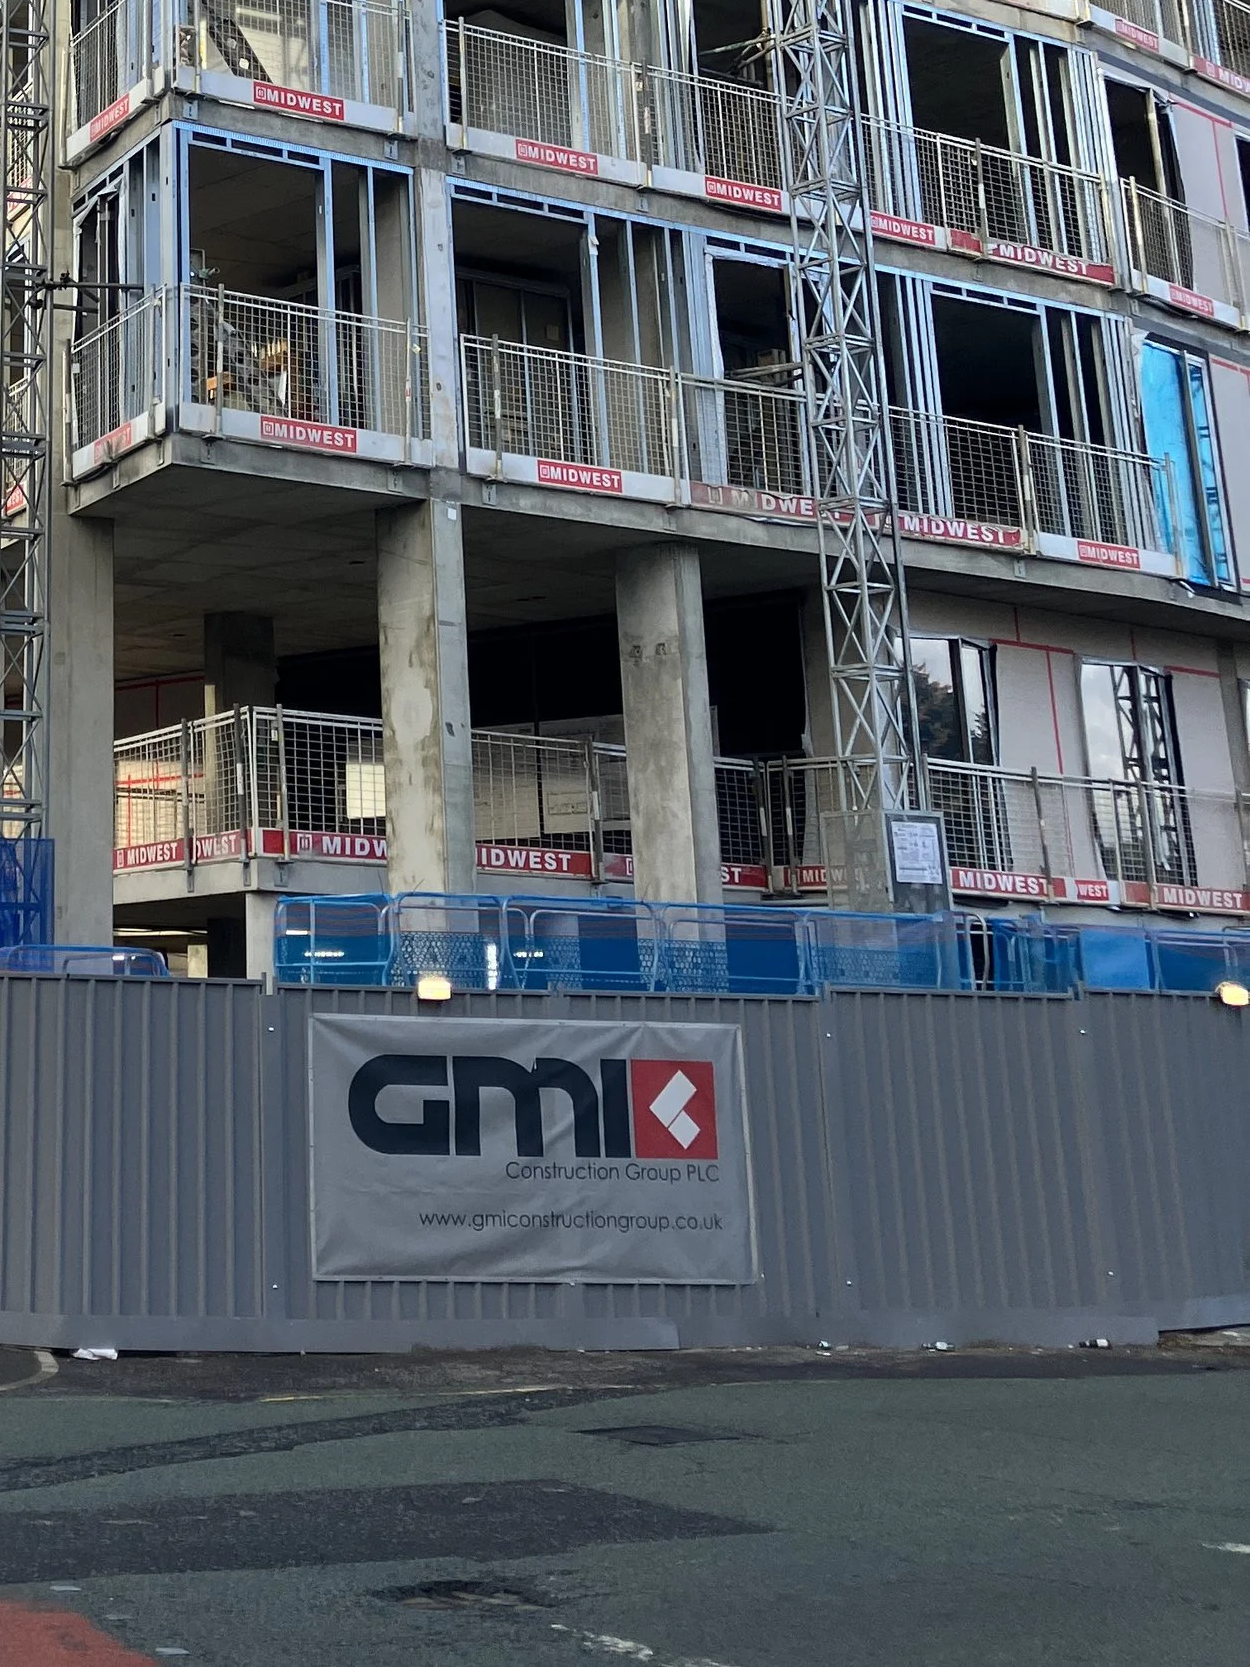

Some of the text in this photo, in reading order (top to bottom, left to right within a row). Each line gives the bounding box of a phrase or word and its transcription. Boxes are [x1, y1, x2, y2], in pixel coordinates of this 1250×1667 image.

[267, 88, 342, 116] MIDWEST
[528, 145, 596, 170] MIDWEST
[716, 182, 779, 207] MIDWEST
[878, 216, 933, 241] MIDWEST
[1000, 244, 1088, 275] MIDWEST
[275, 423, 354, 447] MIDWEST
[550, 466, 620, 488] MIDWEST
[904, 515, 1006, 543] MIDWEST
[1087, 545, 1138, 564] MIDWEST
[127, 842, 178, 865] MIDWEST
[479, 847, 571, 871] IDWEST
[1078, 885, 1107, 897] WEST
[1163, 888, 1242, 908] MIDWEST
[506, 1160, 720, 1185] Construction Group PLC
[418, 1209, 723, 1233] www.gmiconstructiongroup.co.uk
